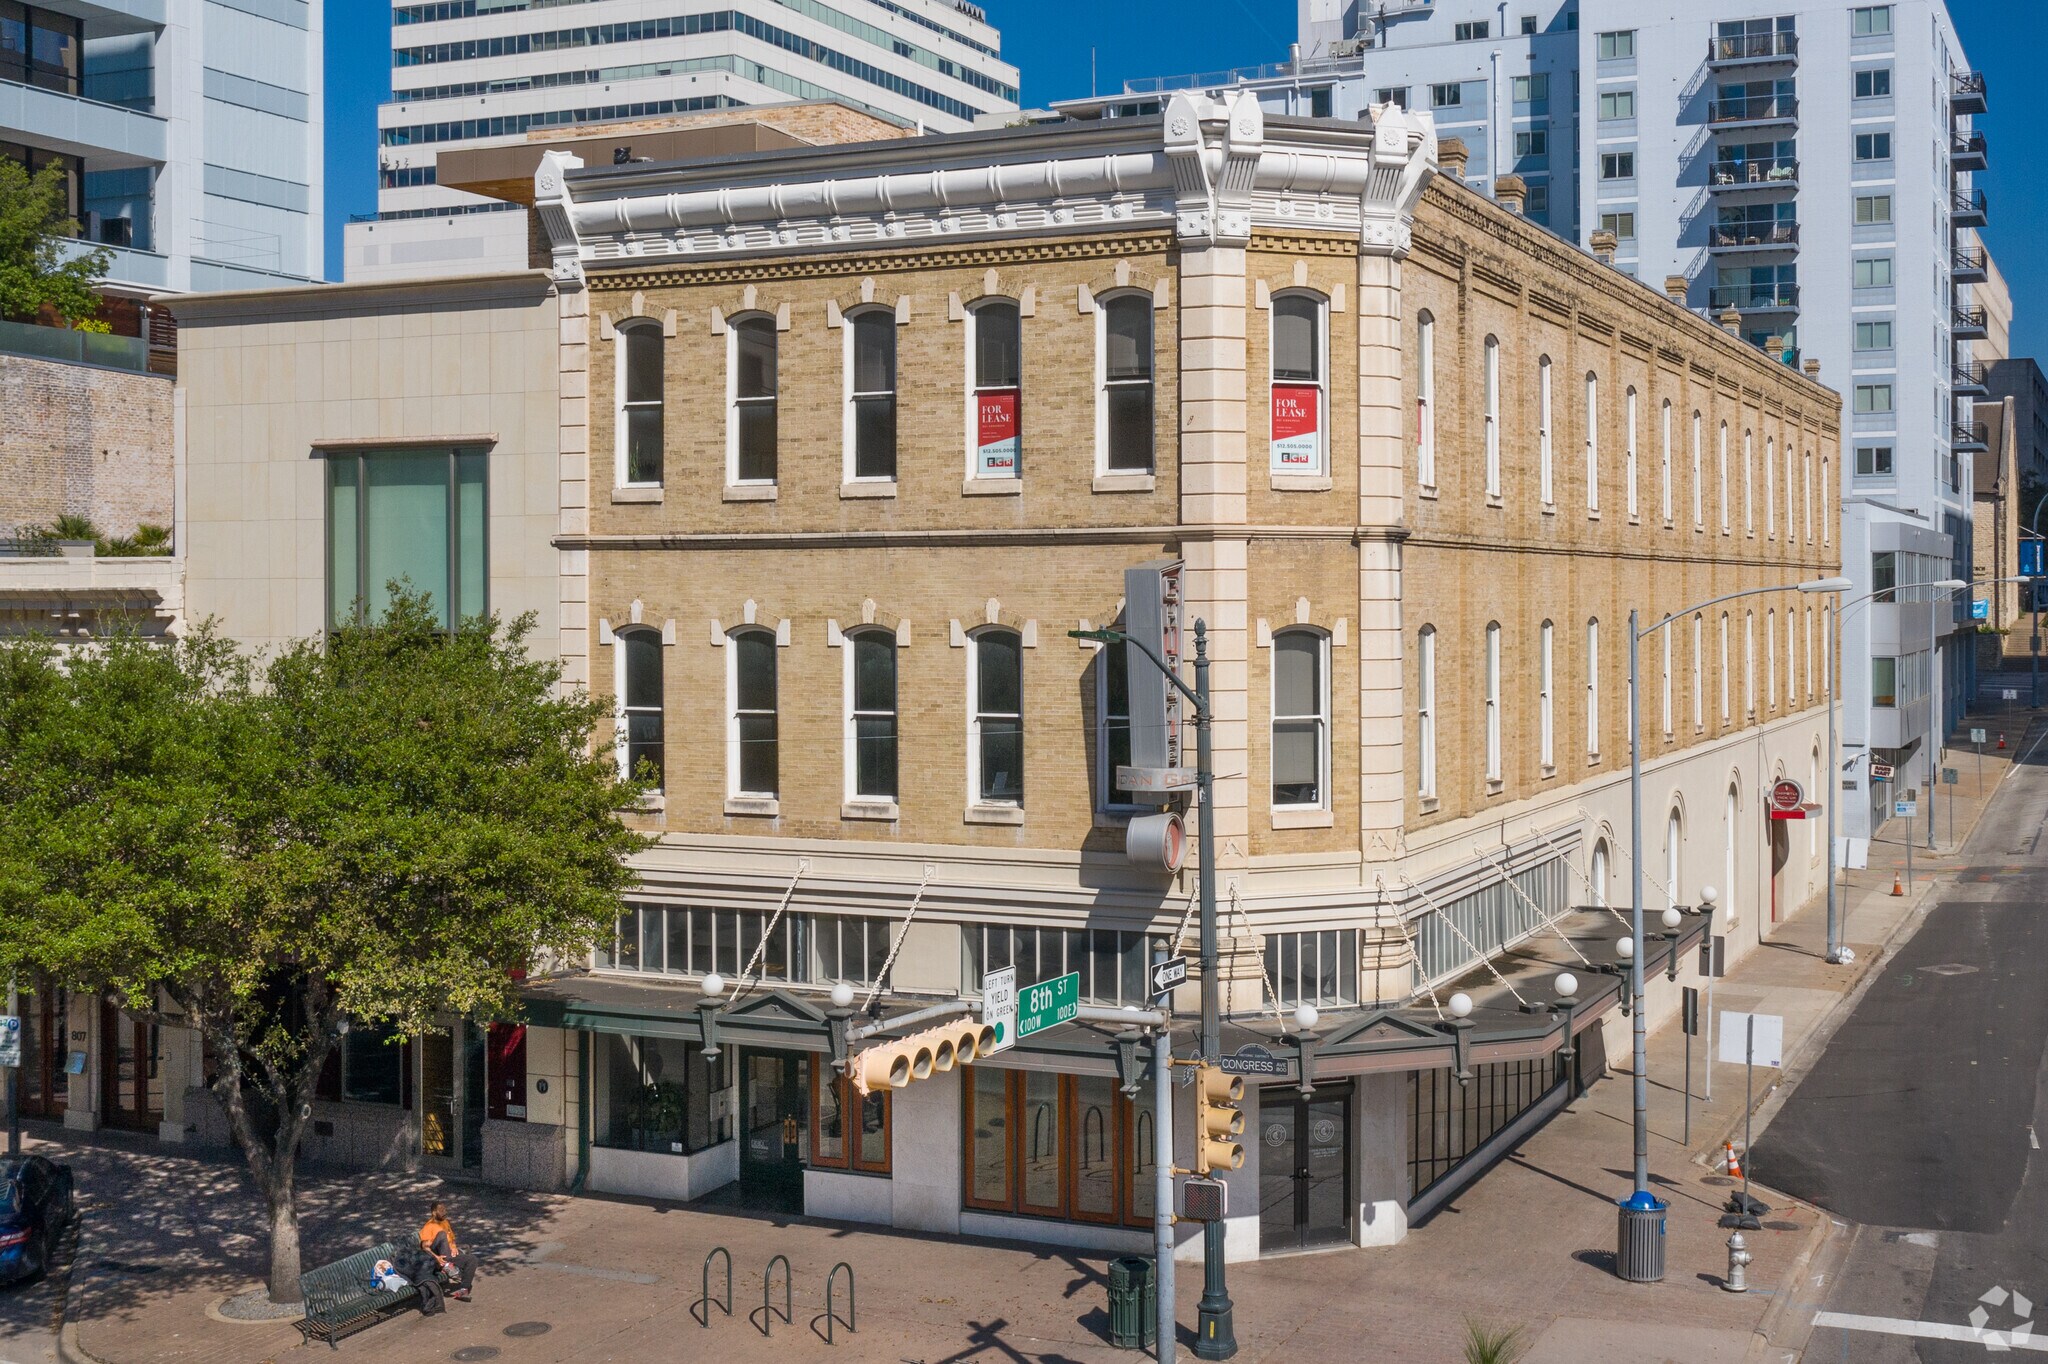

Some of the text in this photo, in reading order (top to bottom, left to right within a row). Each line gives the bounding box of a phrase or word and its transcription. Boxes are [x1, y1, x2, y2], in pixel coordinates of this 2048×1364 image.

[1276, 398, 1297, 408] FOR
[982, 405, 1002, 414] FOR
[1276, 408, 1307, 418] LEASE
[982, 414, 1011, 423] LEASE
[988, 458, 1012, 466] ECR
[1282, 454, 1308, 462] ECR
[1162, 967, 1183, 982] ONE WAY
[985, 974, 1014, 990] LEFT TURN
[991, 989, 1009, 1005] YIELD
[1030, 979, 1068, 1013] 8th ST
[985, 1004, 1013, 1020] ON GREEN
[1024, 1003, 1072, 1032] 100W 100E
[71, 1031, 87, 1042] 807
[1221, 1058, 1274, 1072] CONGRESS
